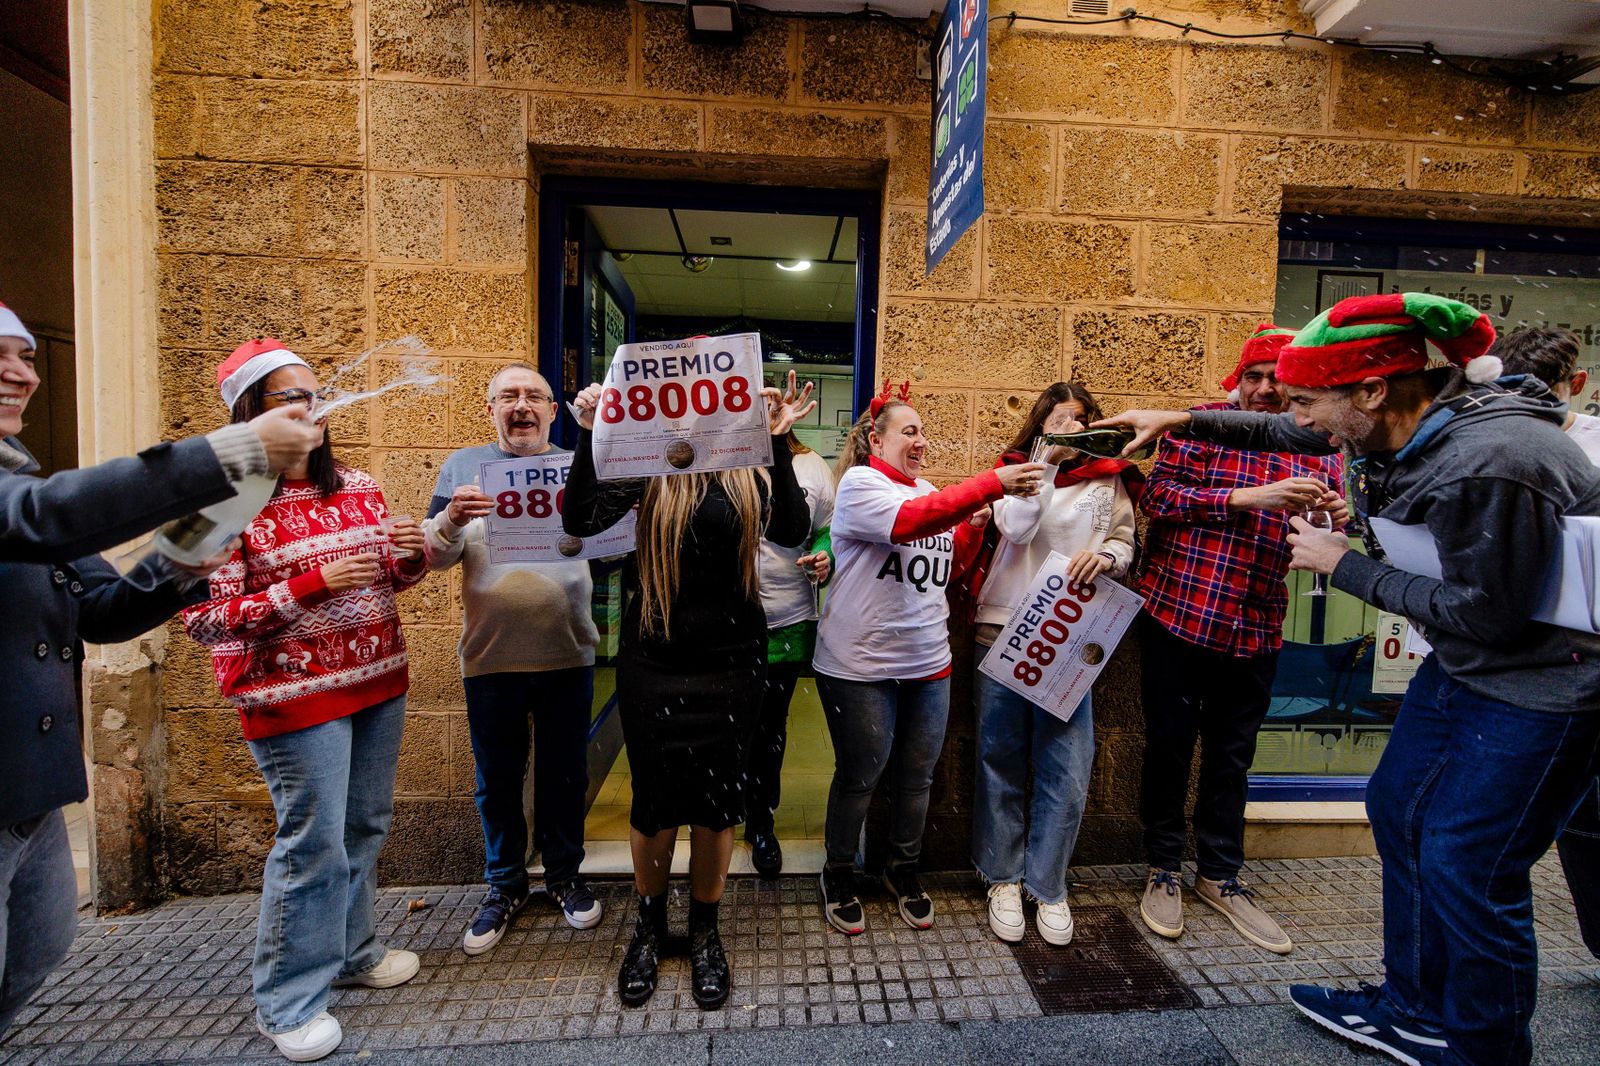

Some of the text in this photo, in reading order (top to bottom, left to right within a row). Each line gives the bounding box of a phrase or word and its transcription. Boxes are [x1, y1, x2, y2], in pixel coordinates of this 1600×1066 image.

[623, 351, 735, 382] PREMIO
[639, 343, 674, 352] VENDIDO
[601, 376, 752, 424] 88008
[876, 551, 949, 593] AQU
[1008, 575, 1064, 651] PREMIO
[1014, 579, 1096, 686] 88008
